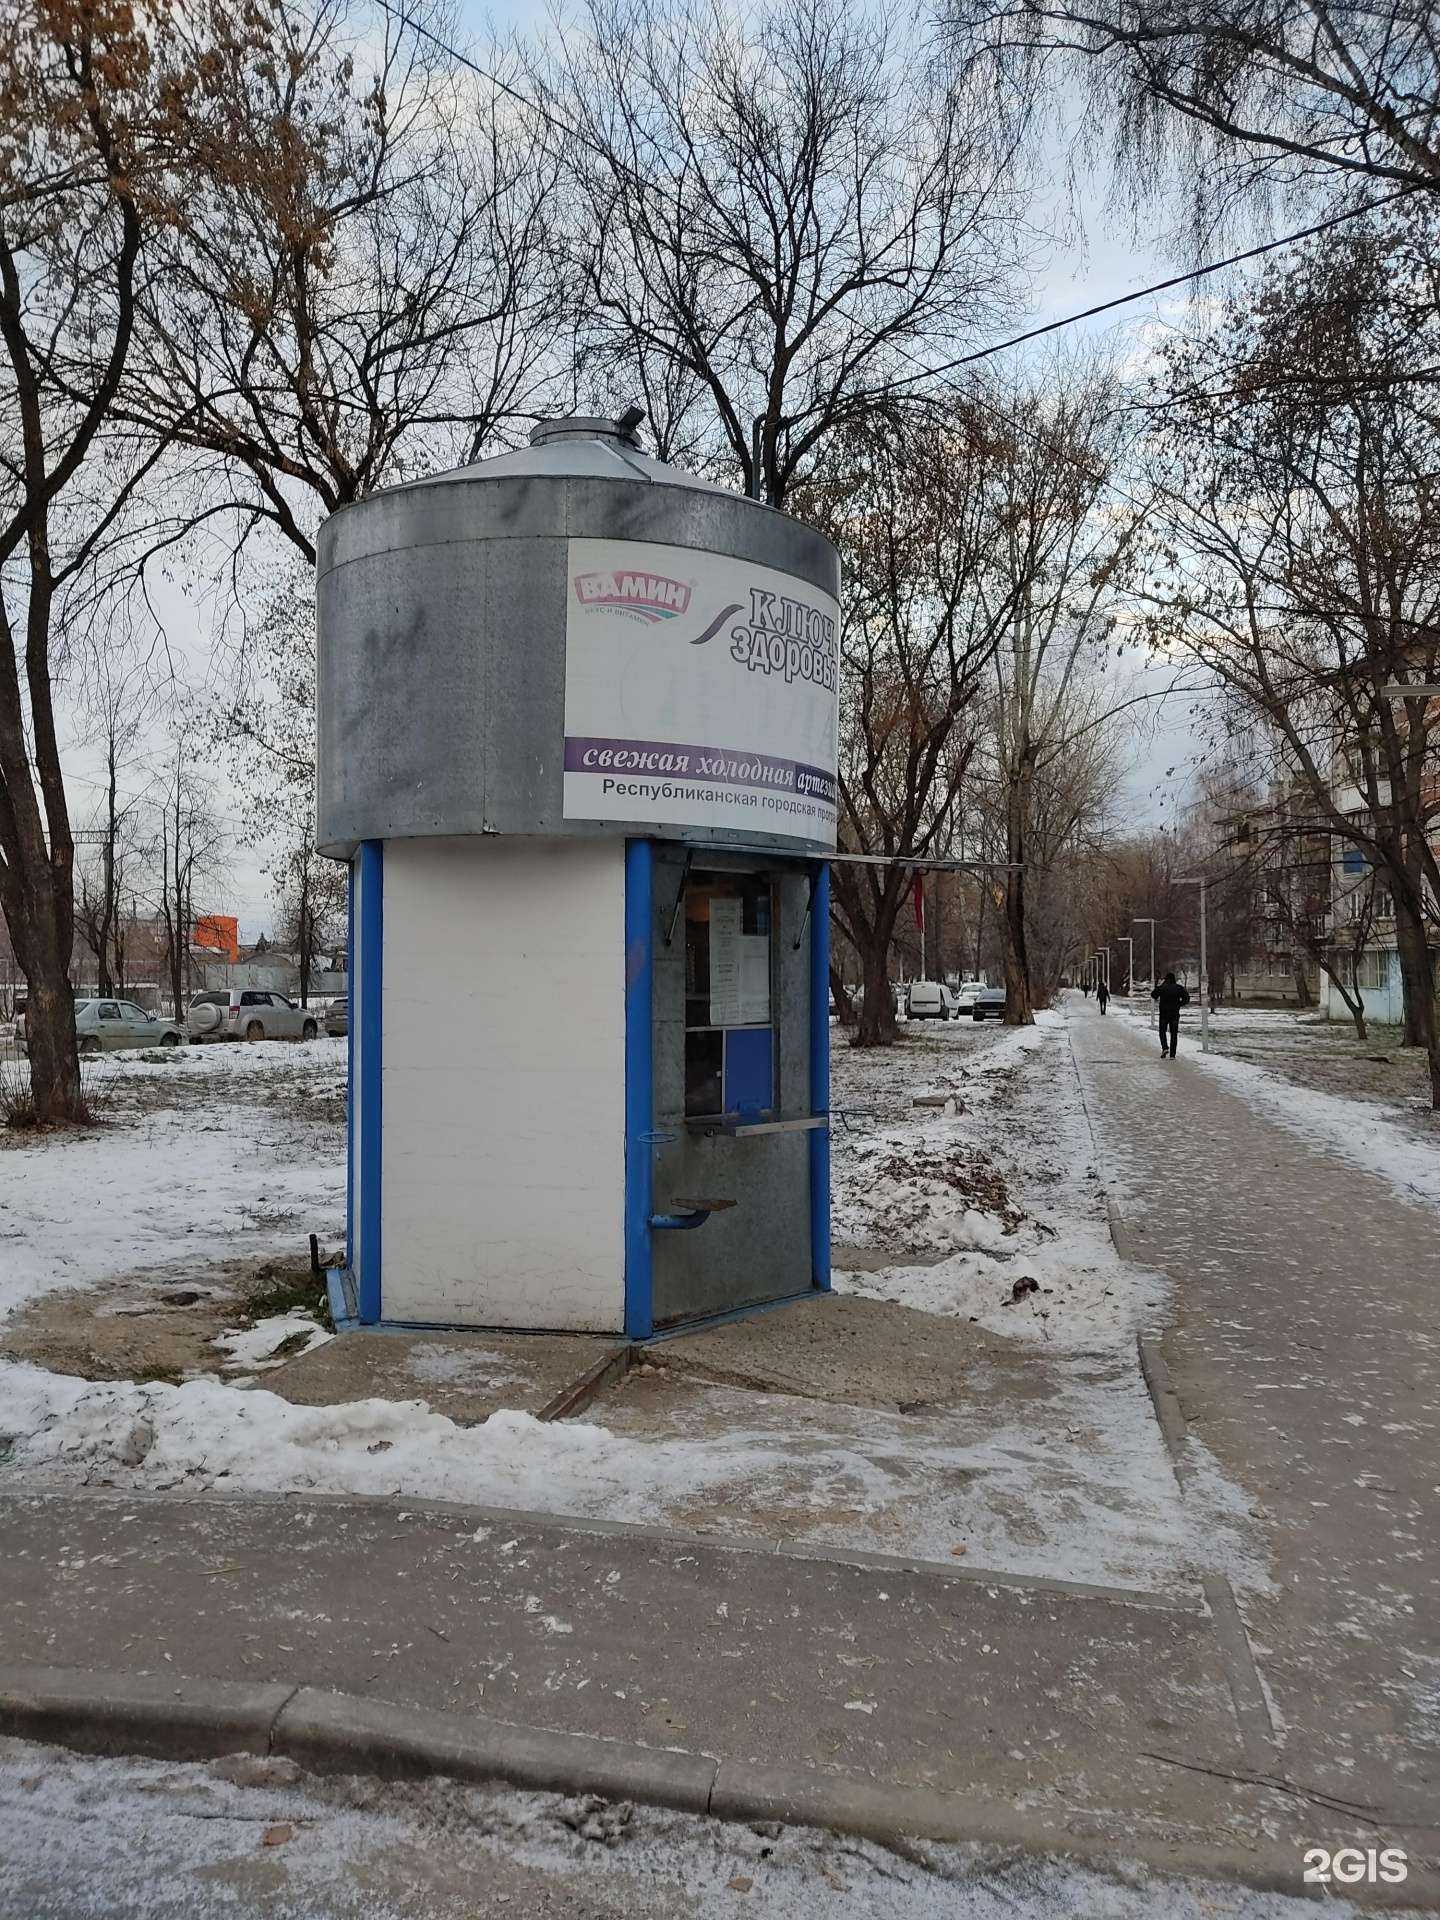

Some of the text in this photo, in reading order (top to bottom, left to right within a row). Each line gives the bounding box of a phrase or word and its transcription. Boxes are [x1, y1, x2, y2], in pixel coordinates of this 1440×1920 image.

[580, 574, 686, 610] ВАМИН
[749, 587, 835, 657] КЛЮЧ
[582, 748, 690, 772] свежая
[695, 756, 794, 787] холодная
[602, 778, 758, 807] Республиканская
[762, 796, 816, 817] городская
